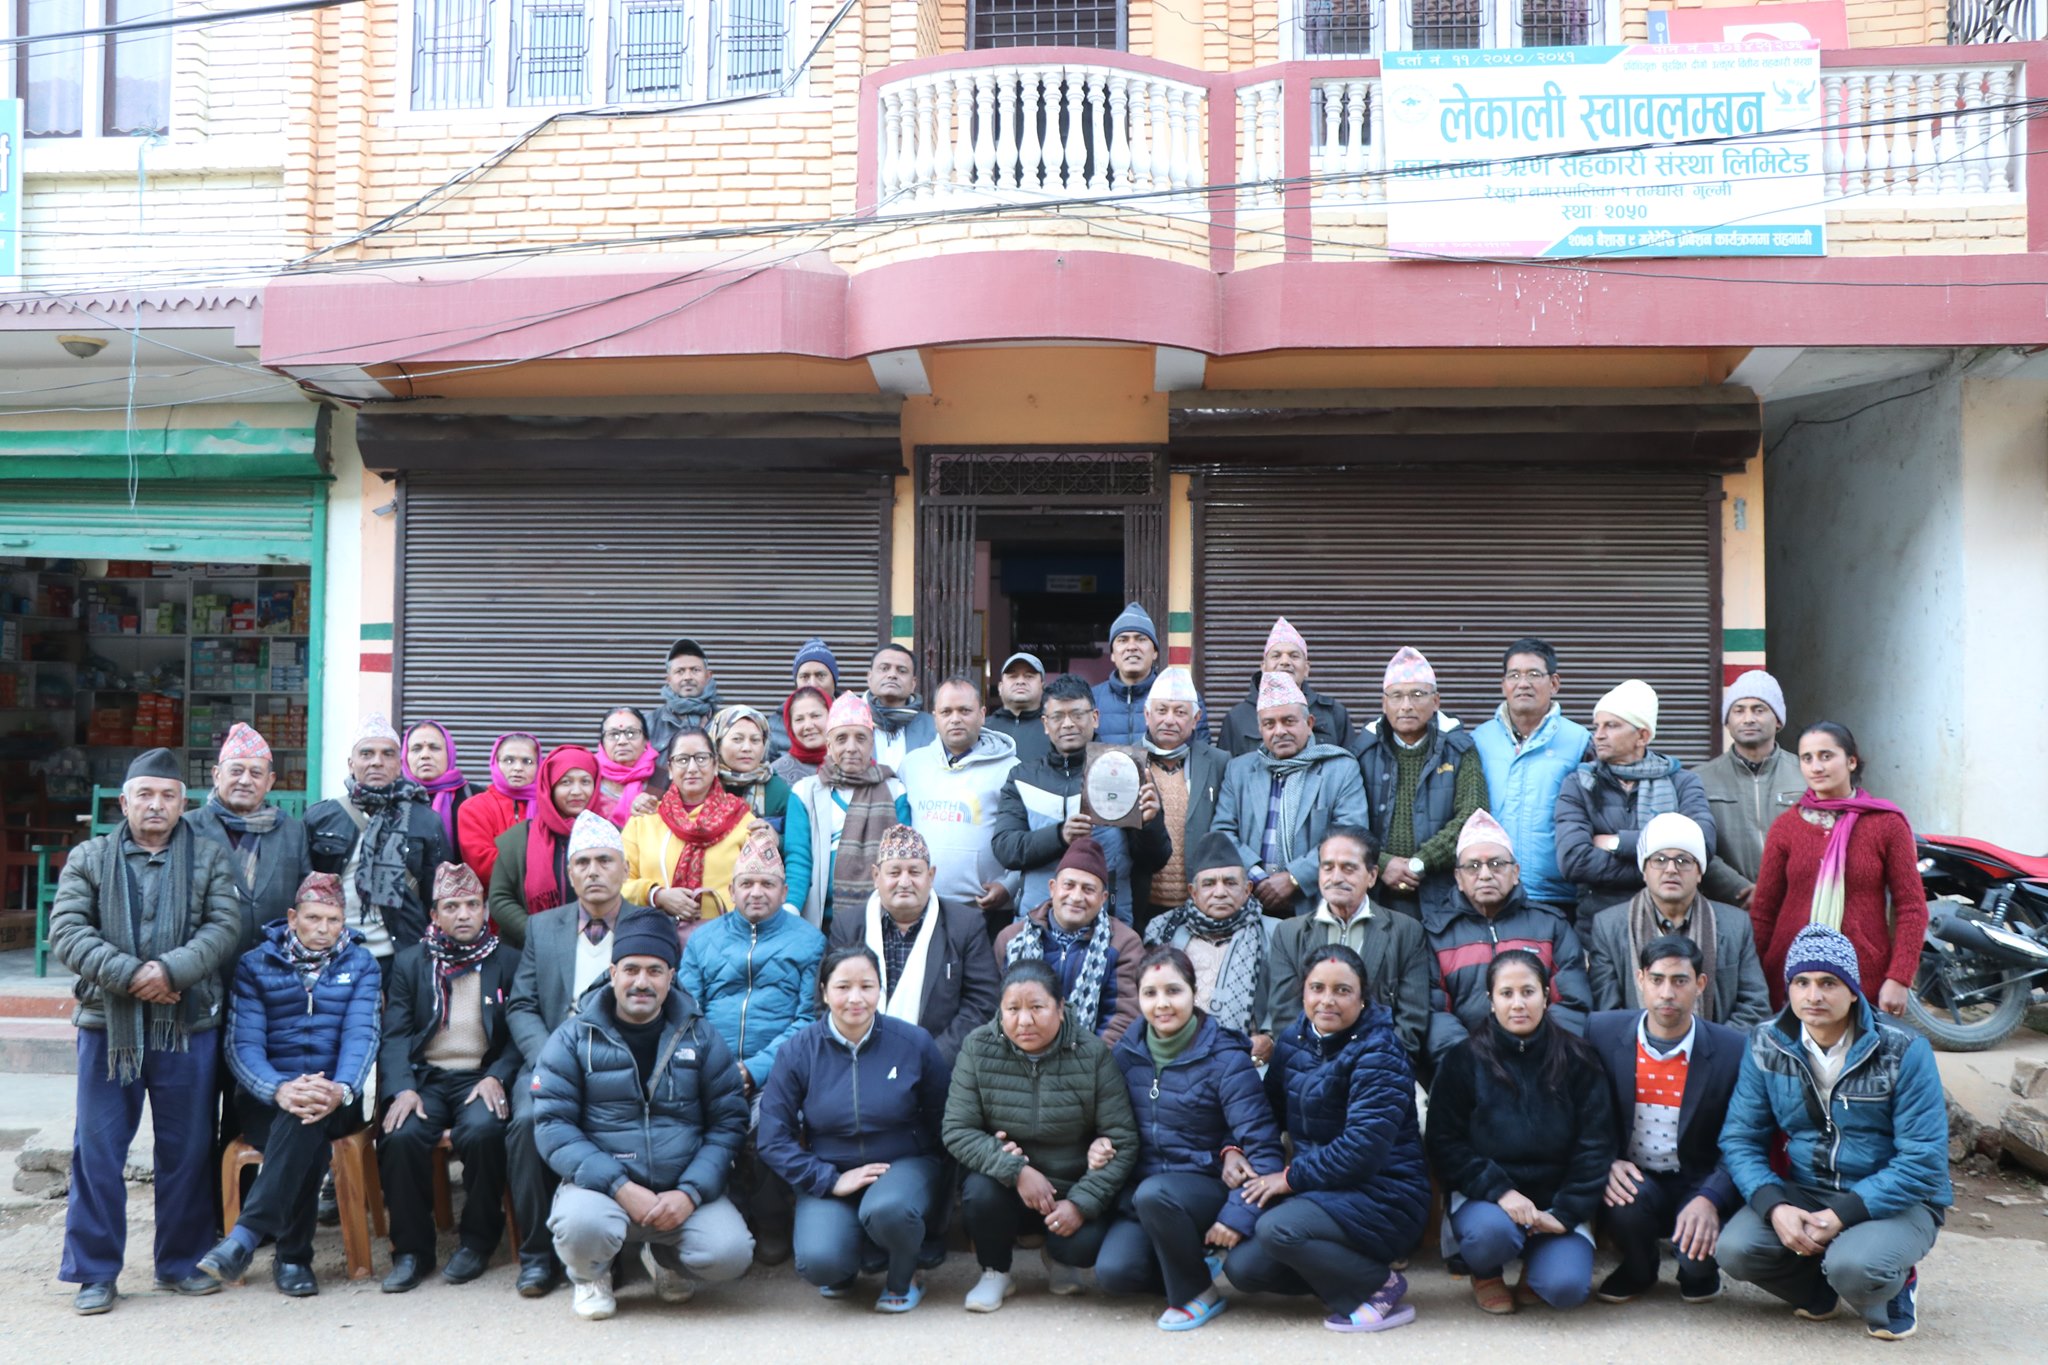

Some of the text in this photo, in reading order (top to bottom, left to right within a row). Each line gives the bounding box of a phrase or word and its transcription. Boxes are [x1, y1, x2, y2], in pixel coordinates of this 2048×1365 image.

[1439, 80, 1567, 143] लेकाली
[1579, 92, 1766, 141] स्वावलम्बन
[1450, 158, 1493, 178] तथा
[1501, 157, 1549, 177] ऋण
[1559, 149, 1647, 178] सहकारी
[1655, 152, 1714, 177] संस्था
[1723, 147, 1810, 176] लिमिटेड
[1693, 181, 1733, 199] गुल्मी
[1604, 204, 1648, 220] २०५०
[918, 799, 957, 811] NORTH
[926, 810, 955, 822] FACE
